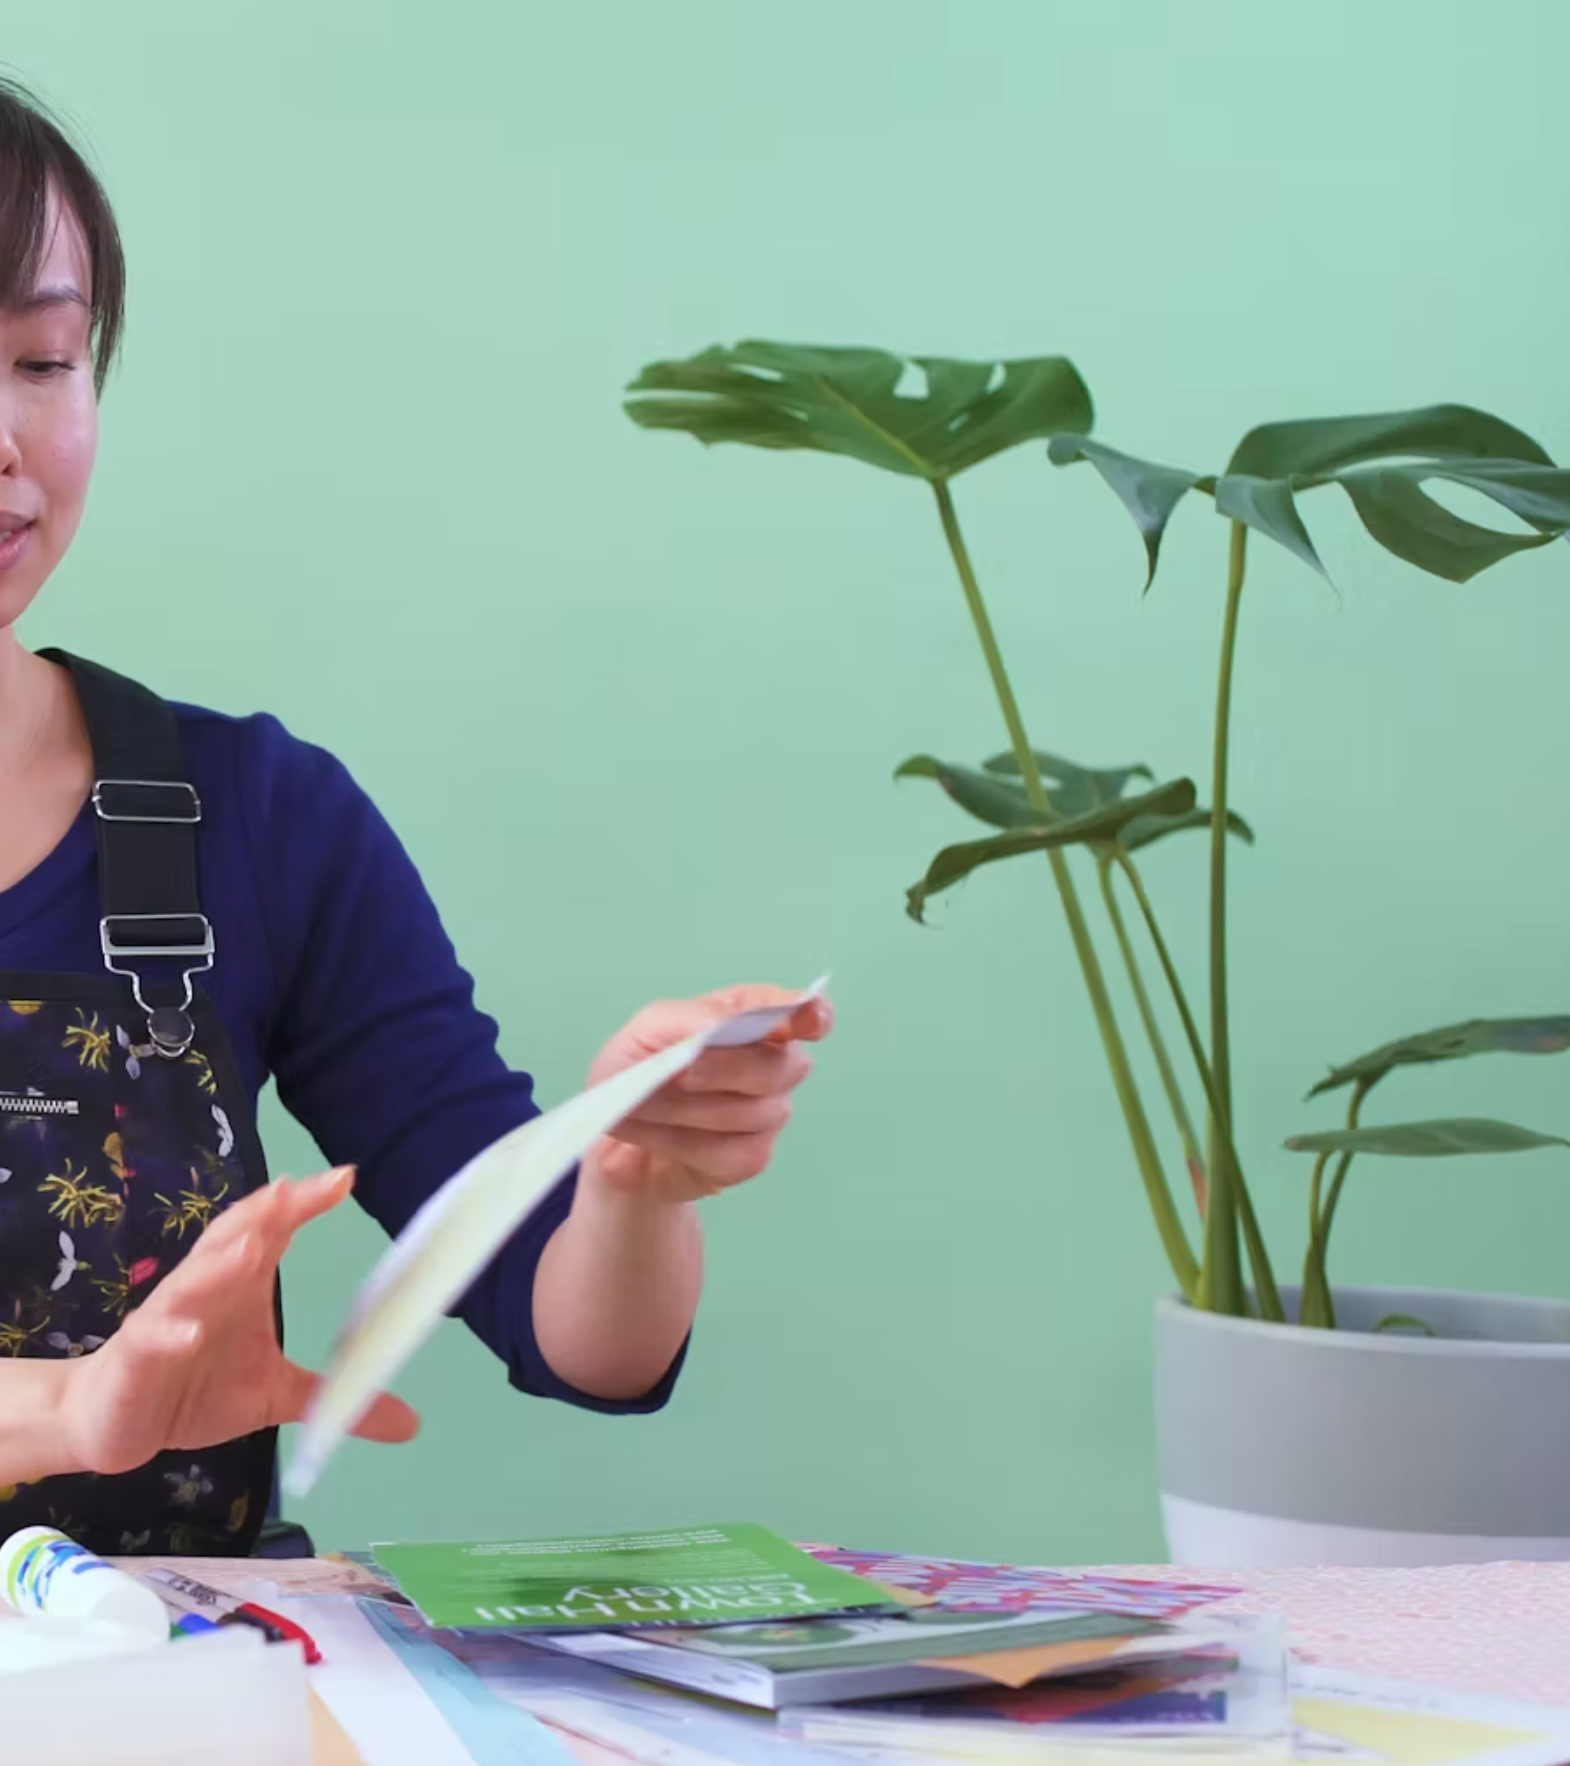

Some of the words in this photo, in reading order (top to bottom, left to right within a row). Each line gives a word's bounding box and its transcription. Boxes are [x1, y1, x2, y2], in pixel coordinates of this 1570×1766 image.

[562, 1582, 807, 1602] Gallery
[624, 1592, 837, 1612] Town
[474, 1600, 617, 1621] Hall
